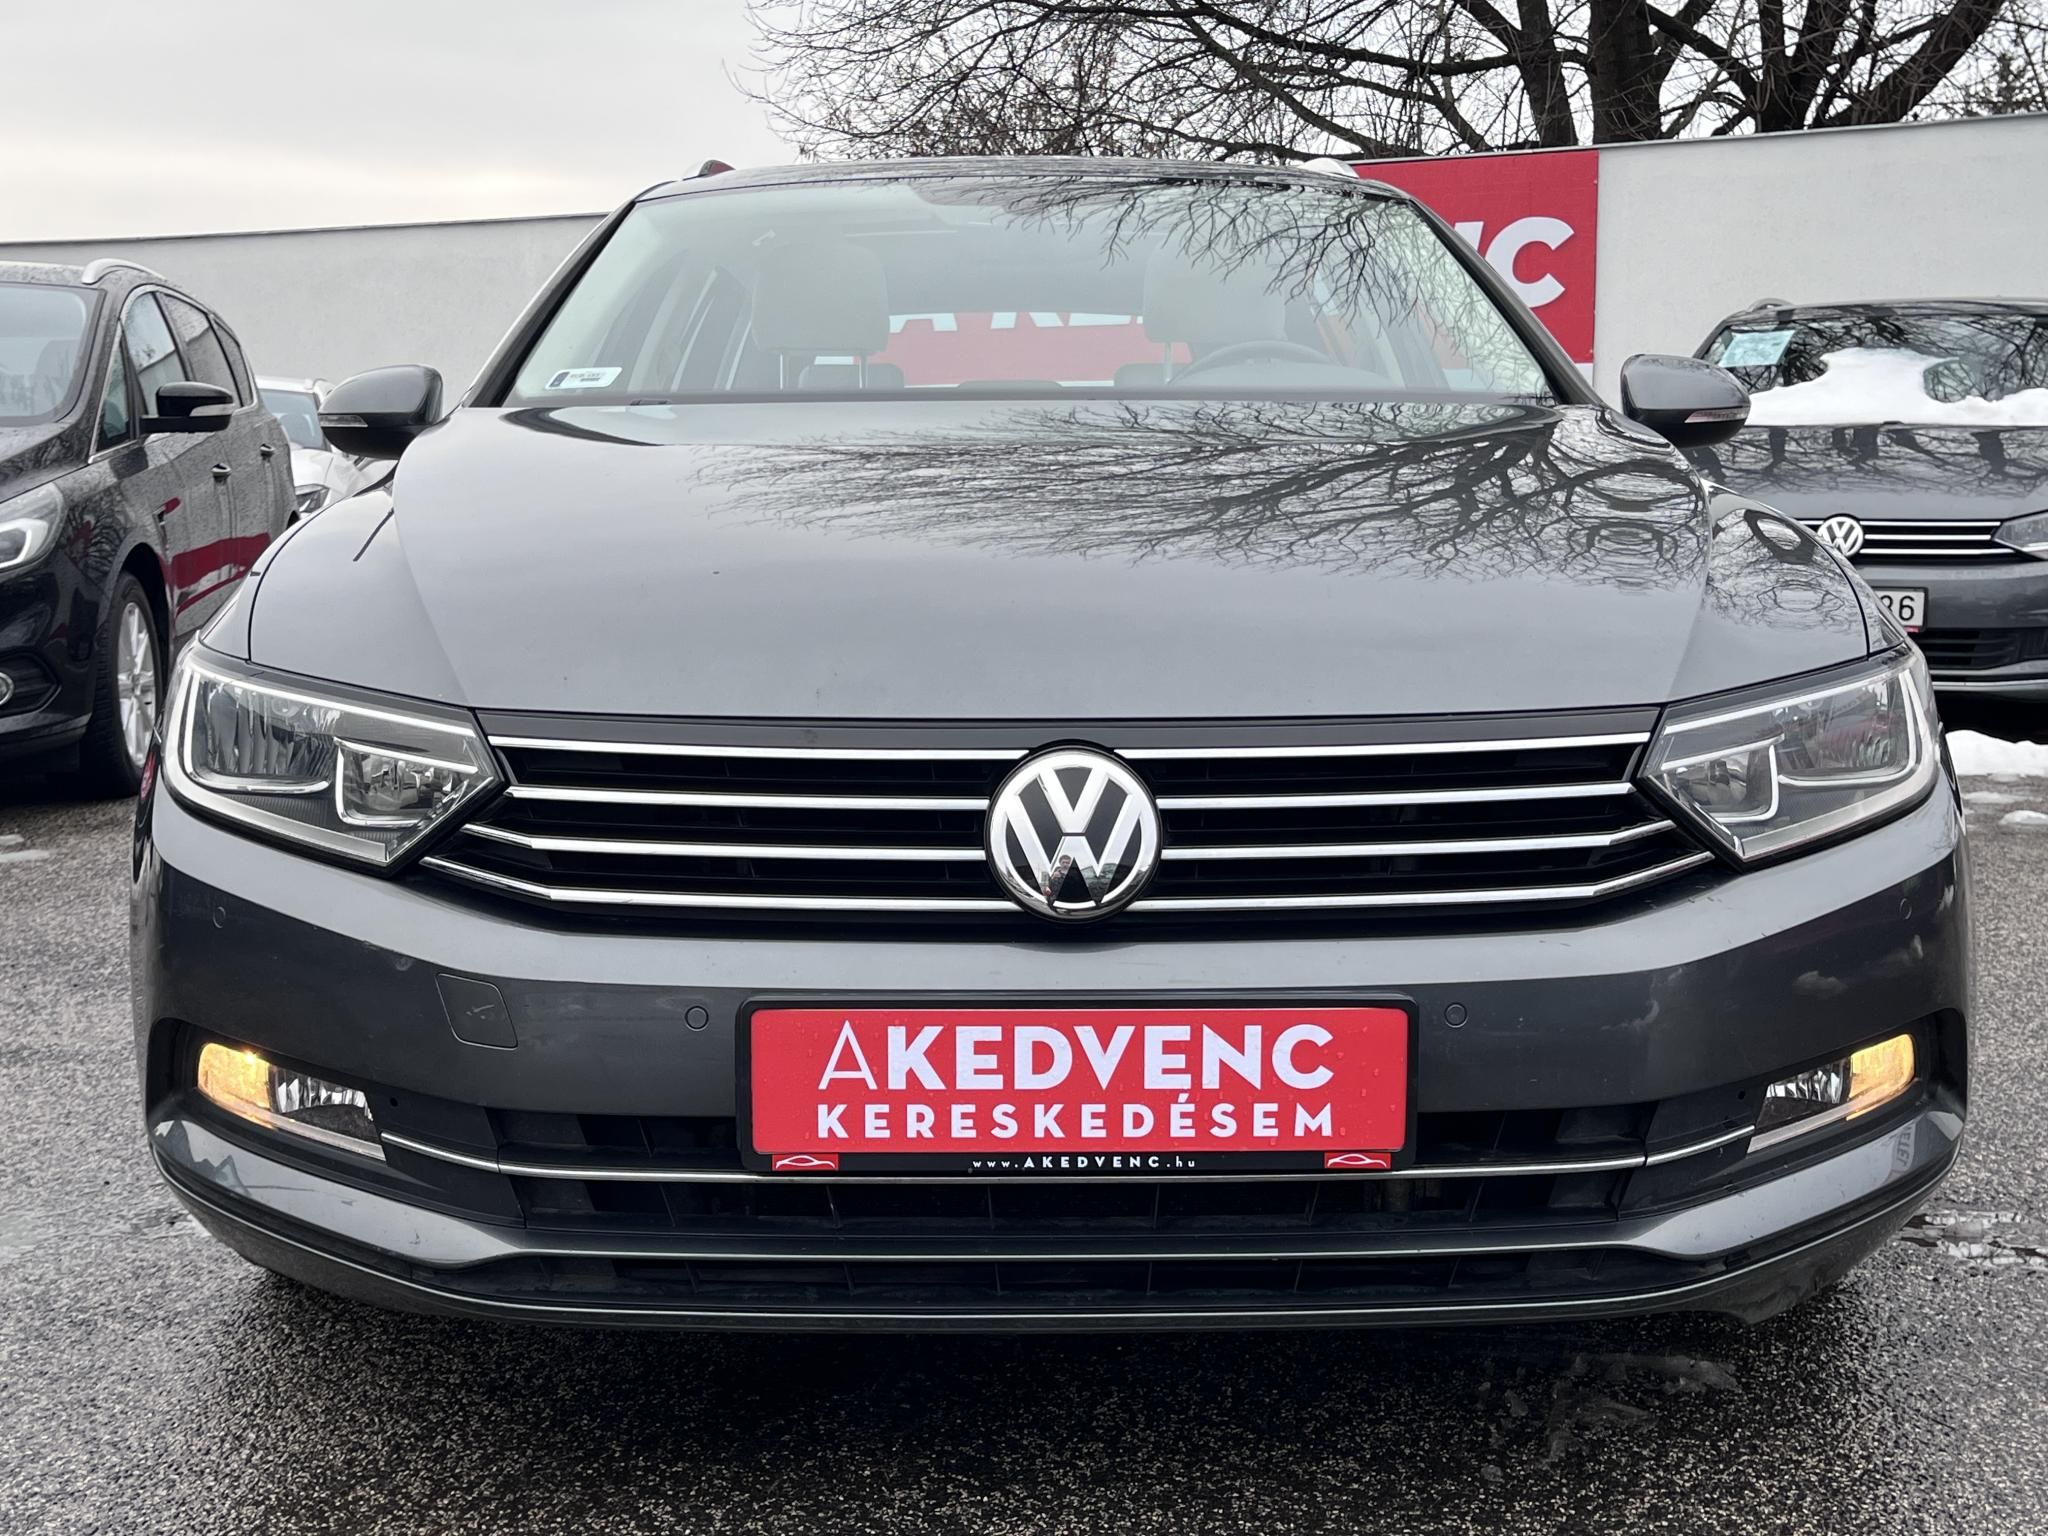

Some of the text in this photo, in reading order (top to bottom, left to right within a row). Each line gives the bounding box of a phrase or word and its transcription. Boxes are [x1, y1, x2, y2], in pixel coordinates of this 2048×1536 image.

[993, 753, 1154, 914] VW
[818, 1020, 1334, 1090] AKEDVENC
[817, 1093, 1332, 1139] KERESKEDÉSEM
[972, 1156, 1195, 1168] www.AKEDVENC.hu
